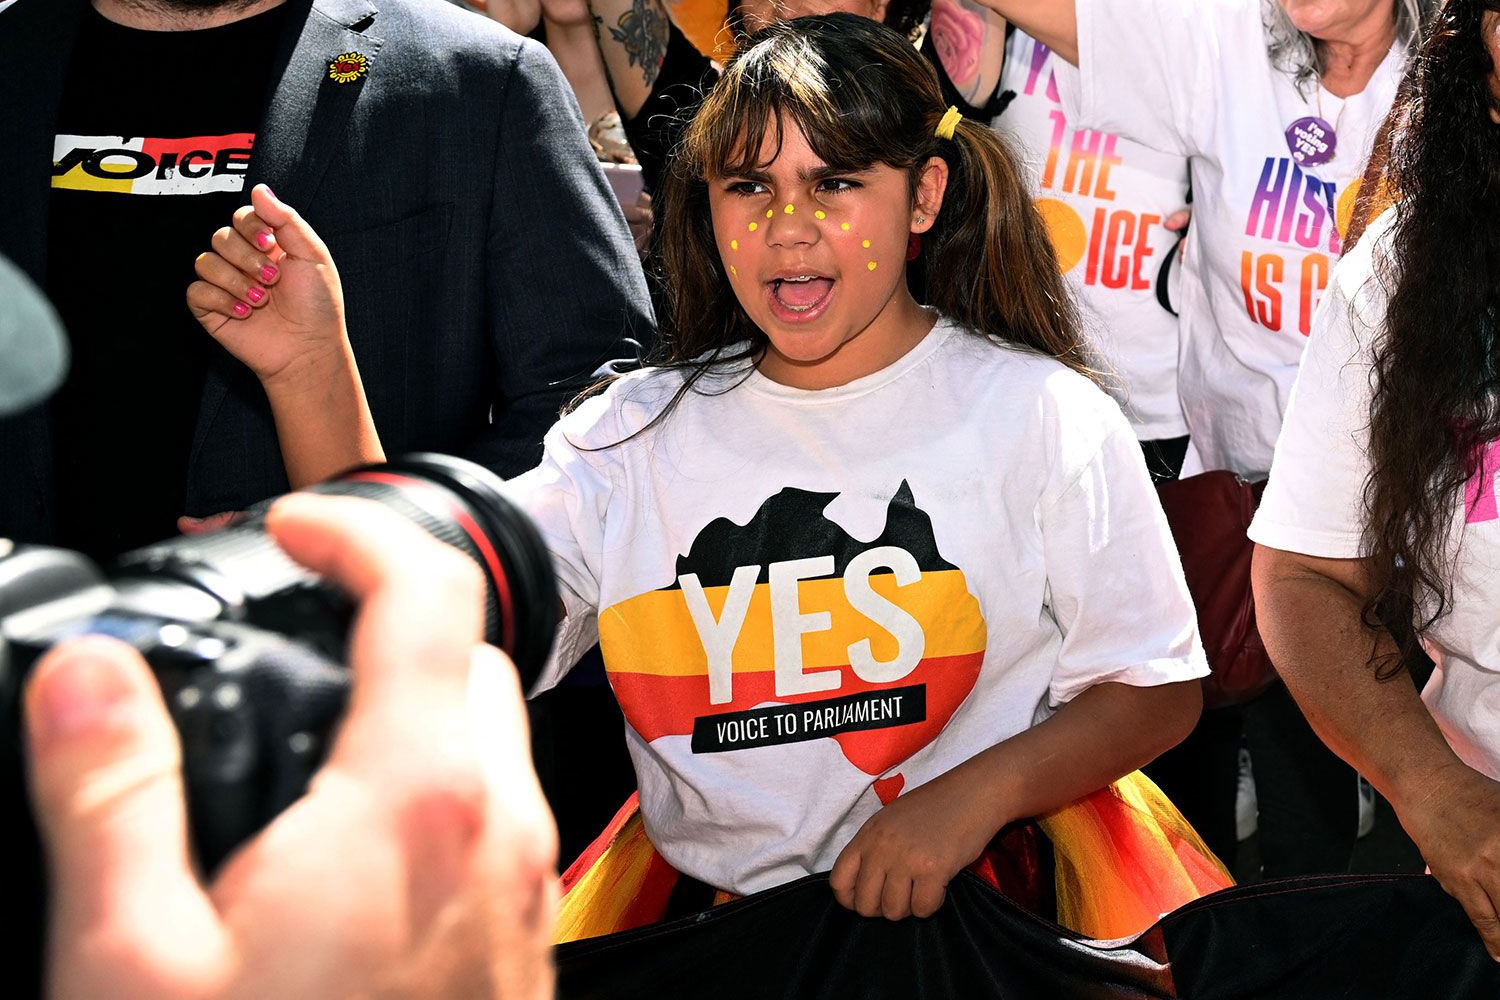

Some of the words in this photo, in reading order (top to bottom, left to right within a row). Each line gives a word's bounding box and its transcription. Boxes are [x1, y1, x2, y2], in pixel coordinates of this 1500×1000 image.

[335, 62, 360, 73] Yes
[1294, 126, 1329, 153] voting
[1295, 137, 1317, 156] YES
[1307, 122, 1325, 138] I'm
[51, 147, 254, 180] VOICE
[1041, 109, 1123, 201] THE
[1241, 250, 1284, 332] IS
[678, 546, 926, 706] YES
[717, 717, 769, 744] VOICE
[774, 713, 797, 735] TO
[803, 696, 903, 732] PARLIAMENT
